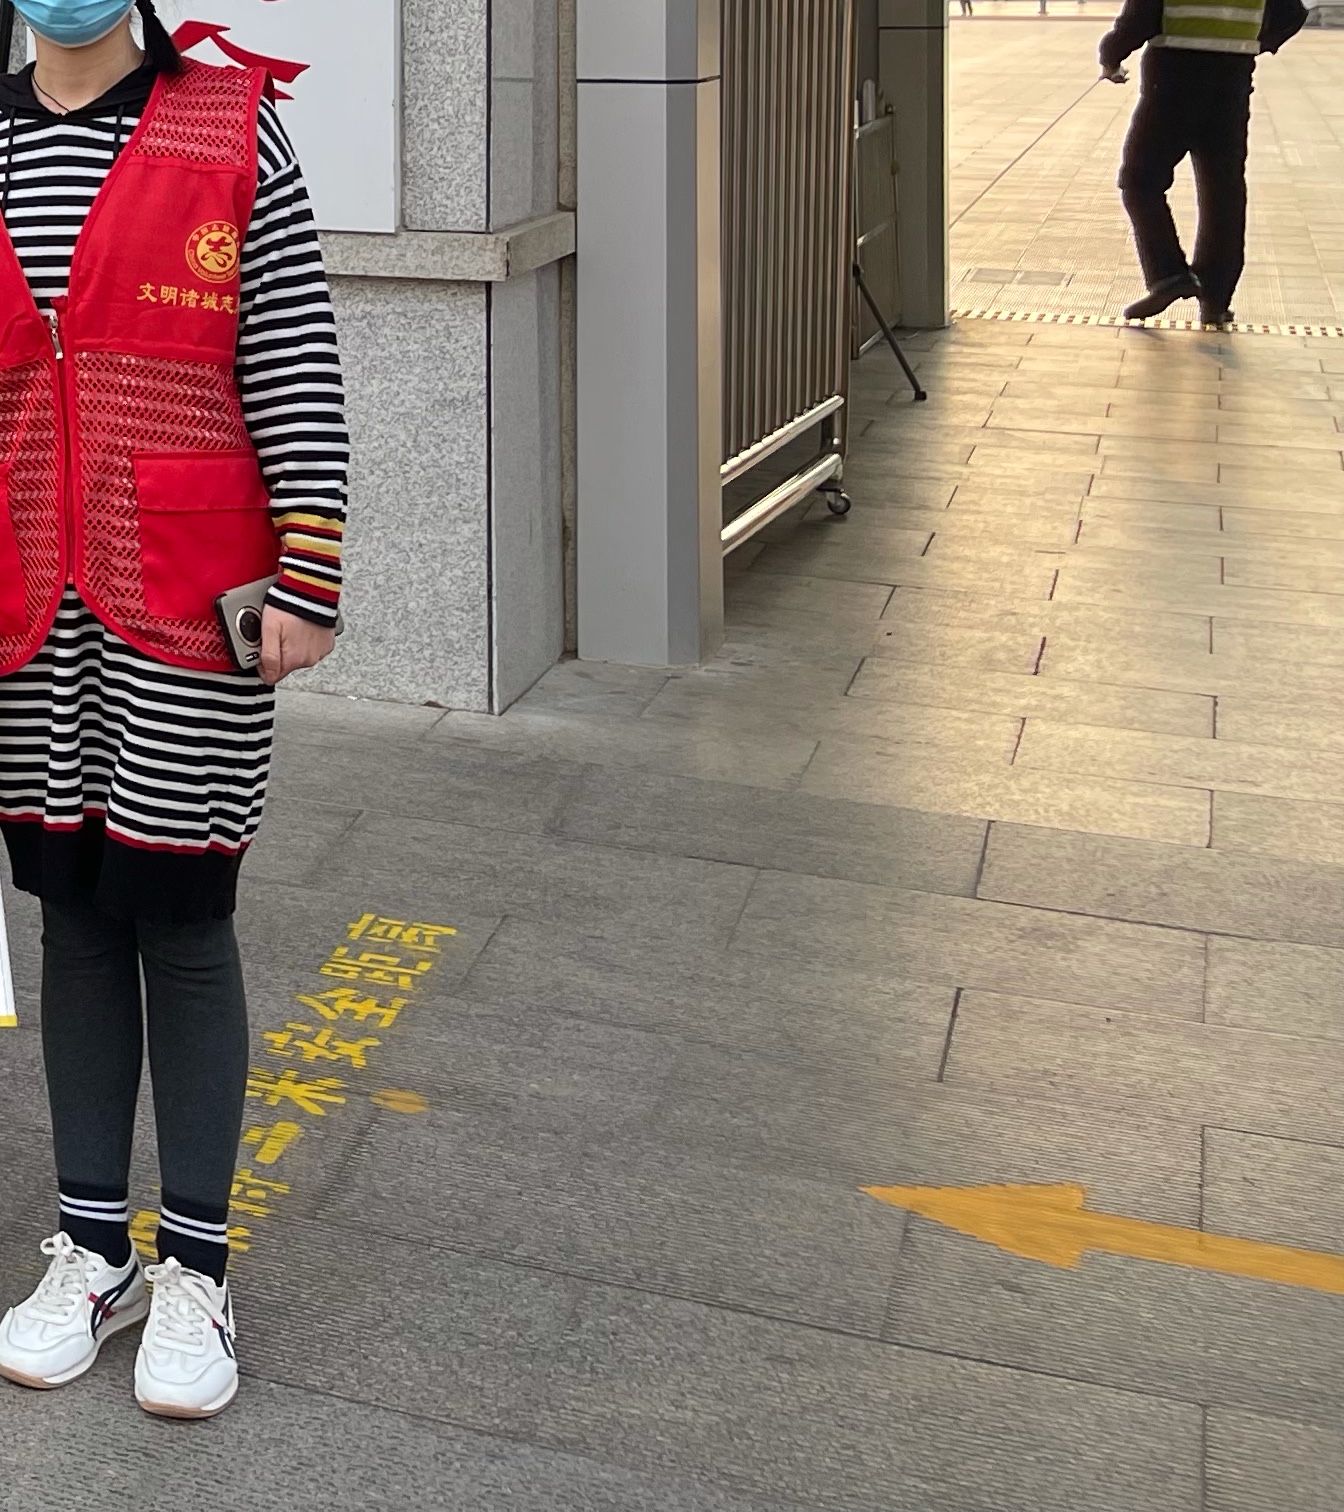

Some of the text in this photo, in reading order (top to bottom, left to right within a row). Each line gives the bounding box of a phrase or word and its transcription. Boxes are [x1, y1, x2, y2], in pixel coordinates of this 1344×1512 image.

[136, 282, 240, 315] 文明诸城志
